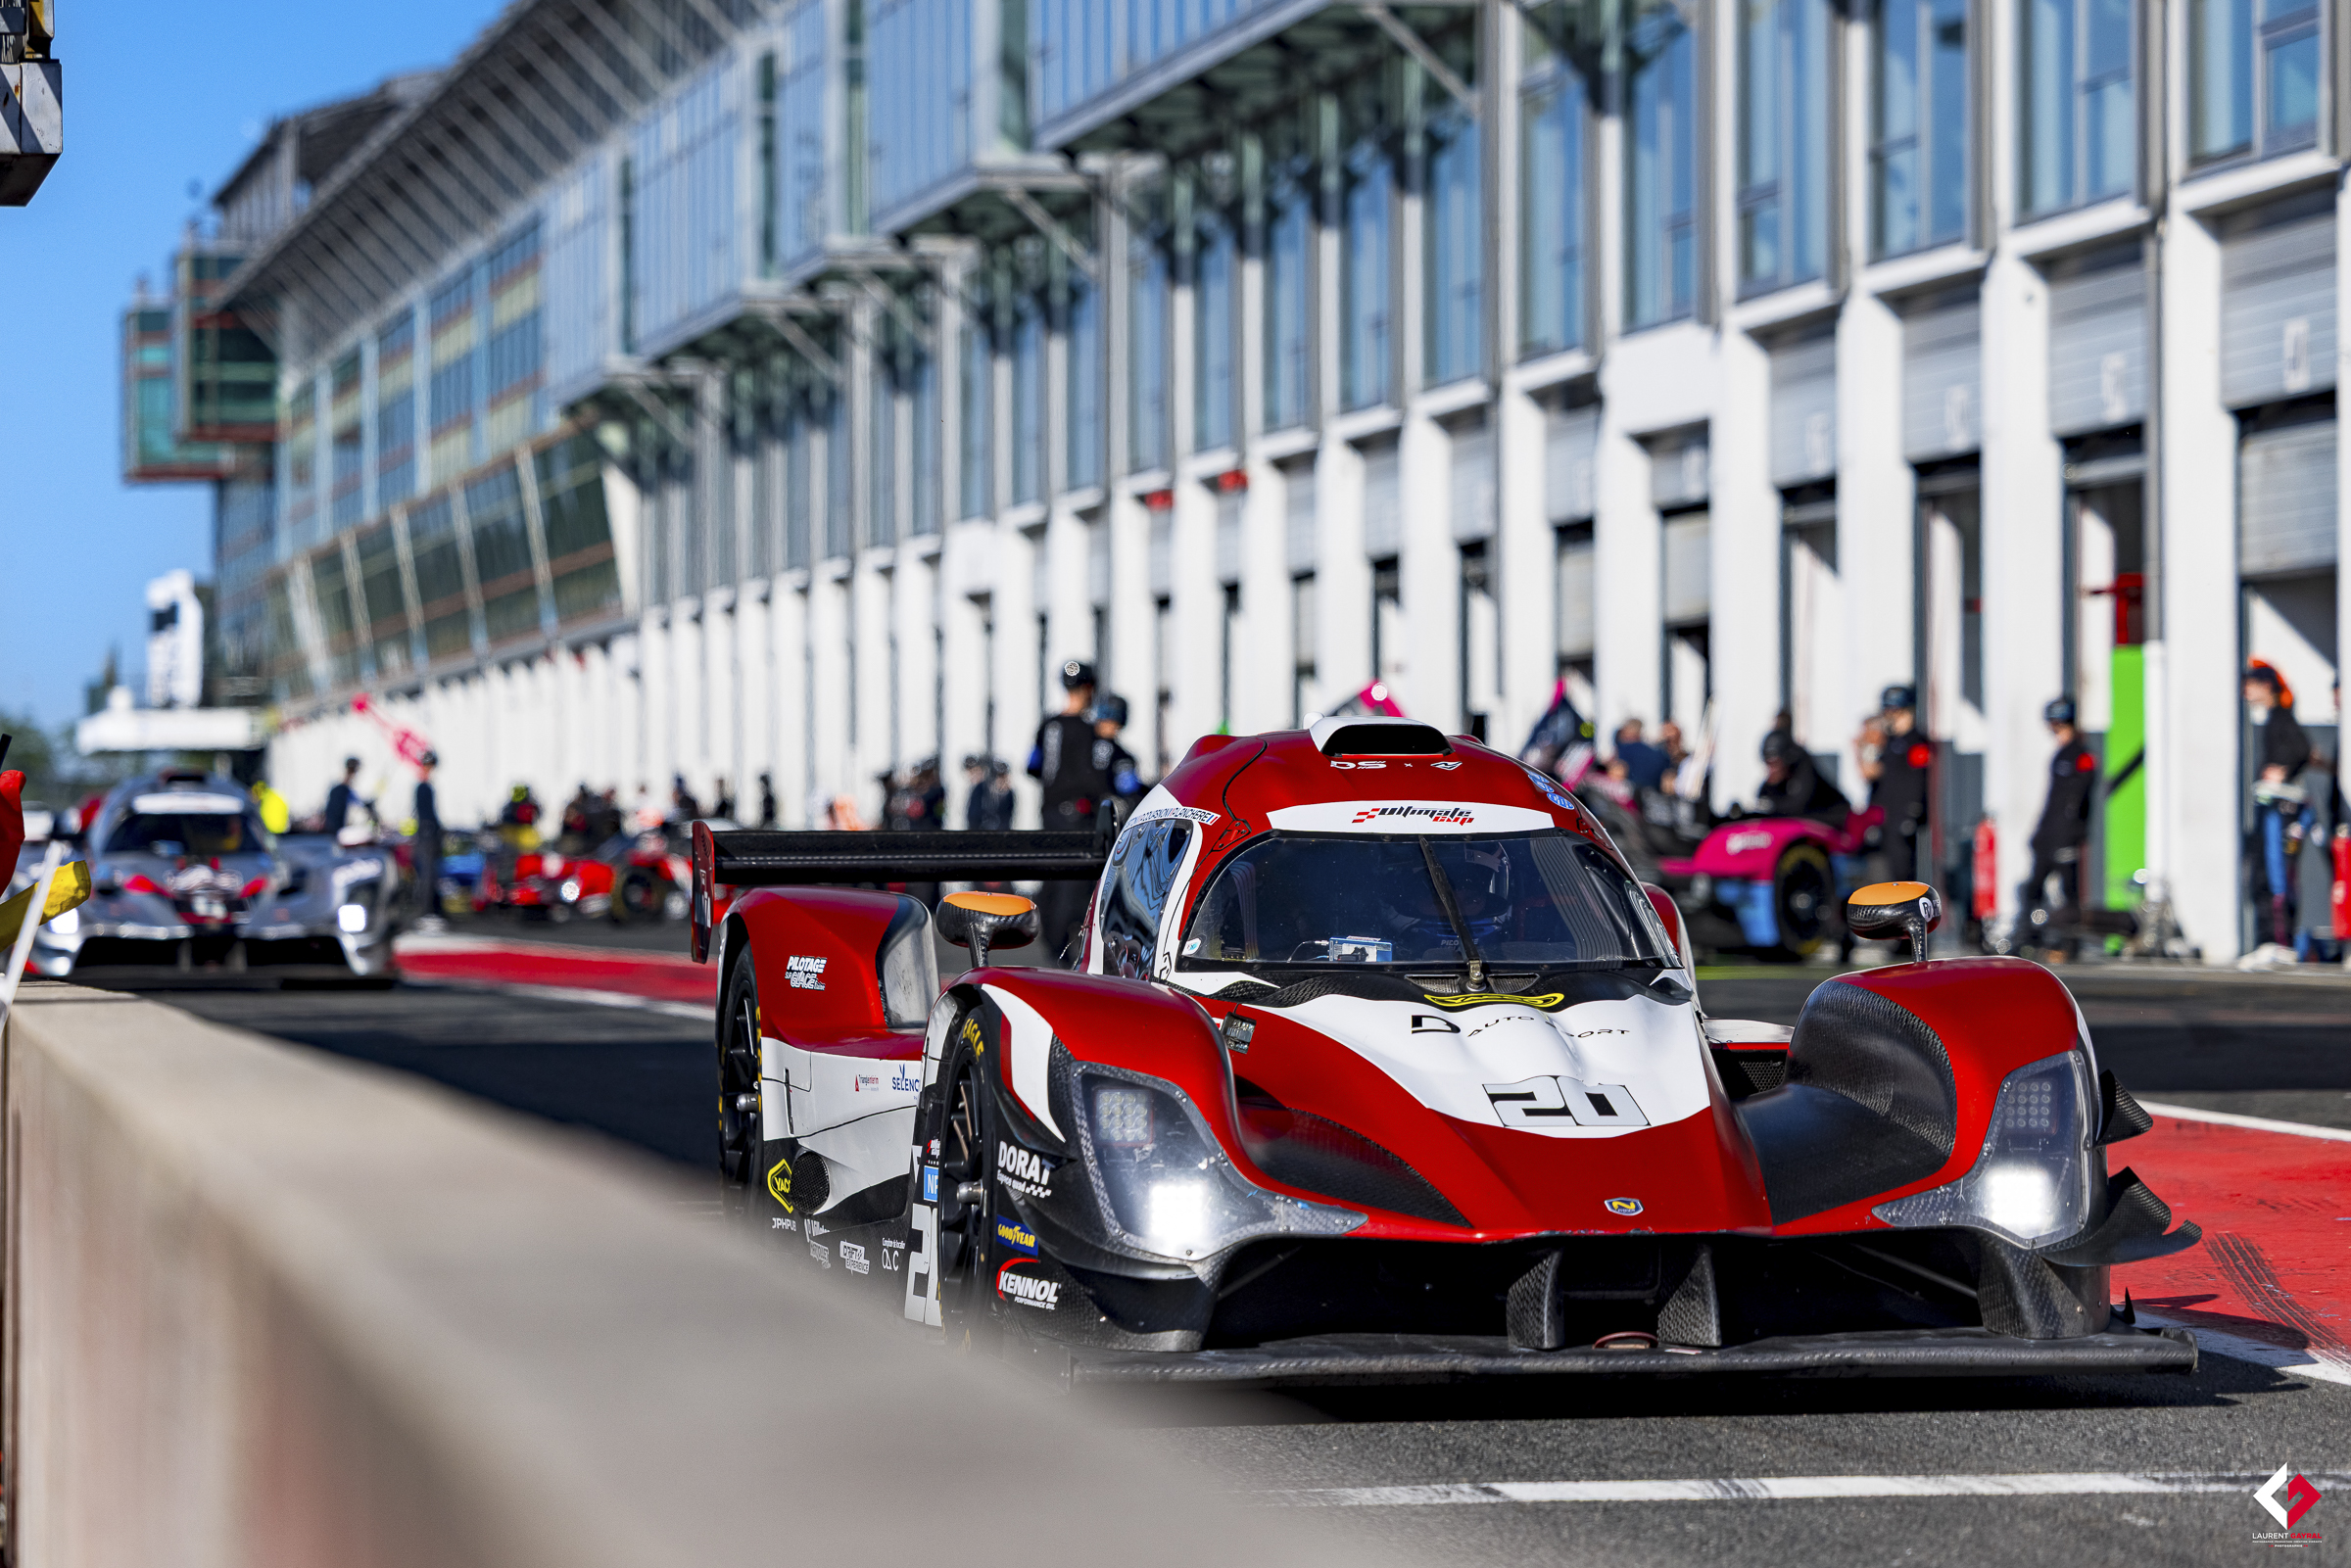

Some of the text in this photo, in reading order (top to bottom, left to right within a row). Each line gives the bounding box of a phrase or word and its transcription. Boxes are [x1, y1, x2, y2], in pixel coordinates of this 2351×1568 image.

[787, 956, 827, 974] PILOTAGE
[963, 1018, 984, 1063] EAGLE
[1482, 1074, 1652, 1128] 20
[998, 1140, 1056, 1185] DORAT
[999, 1270, 1058, 1304] KENNOL
